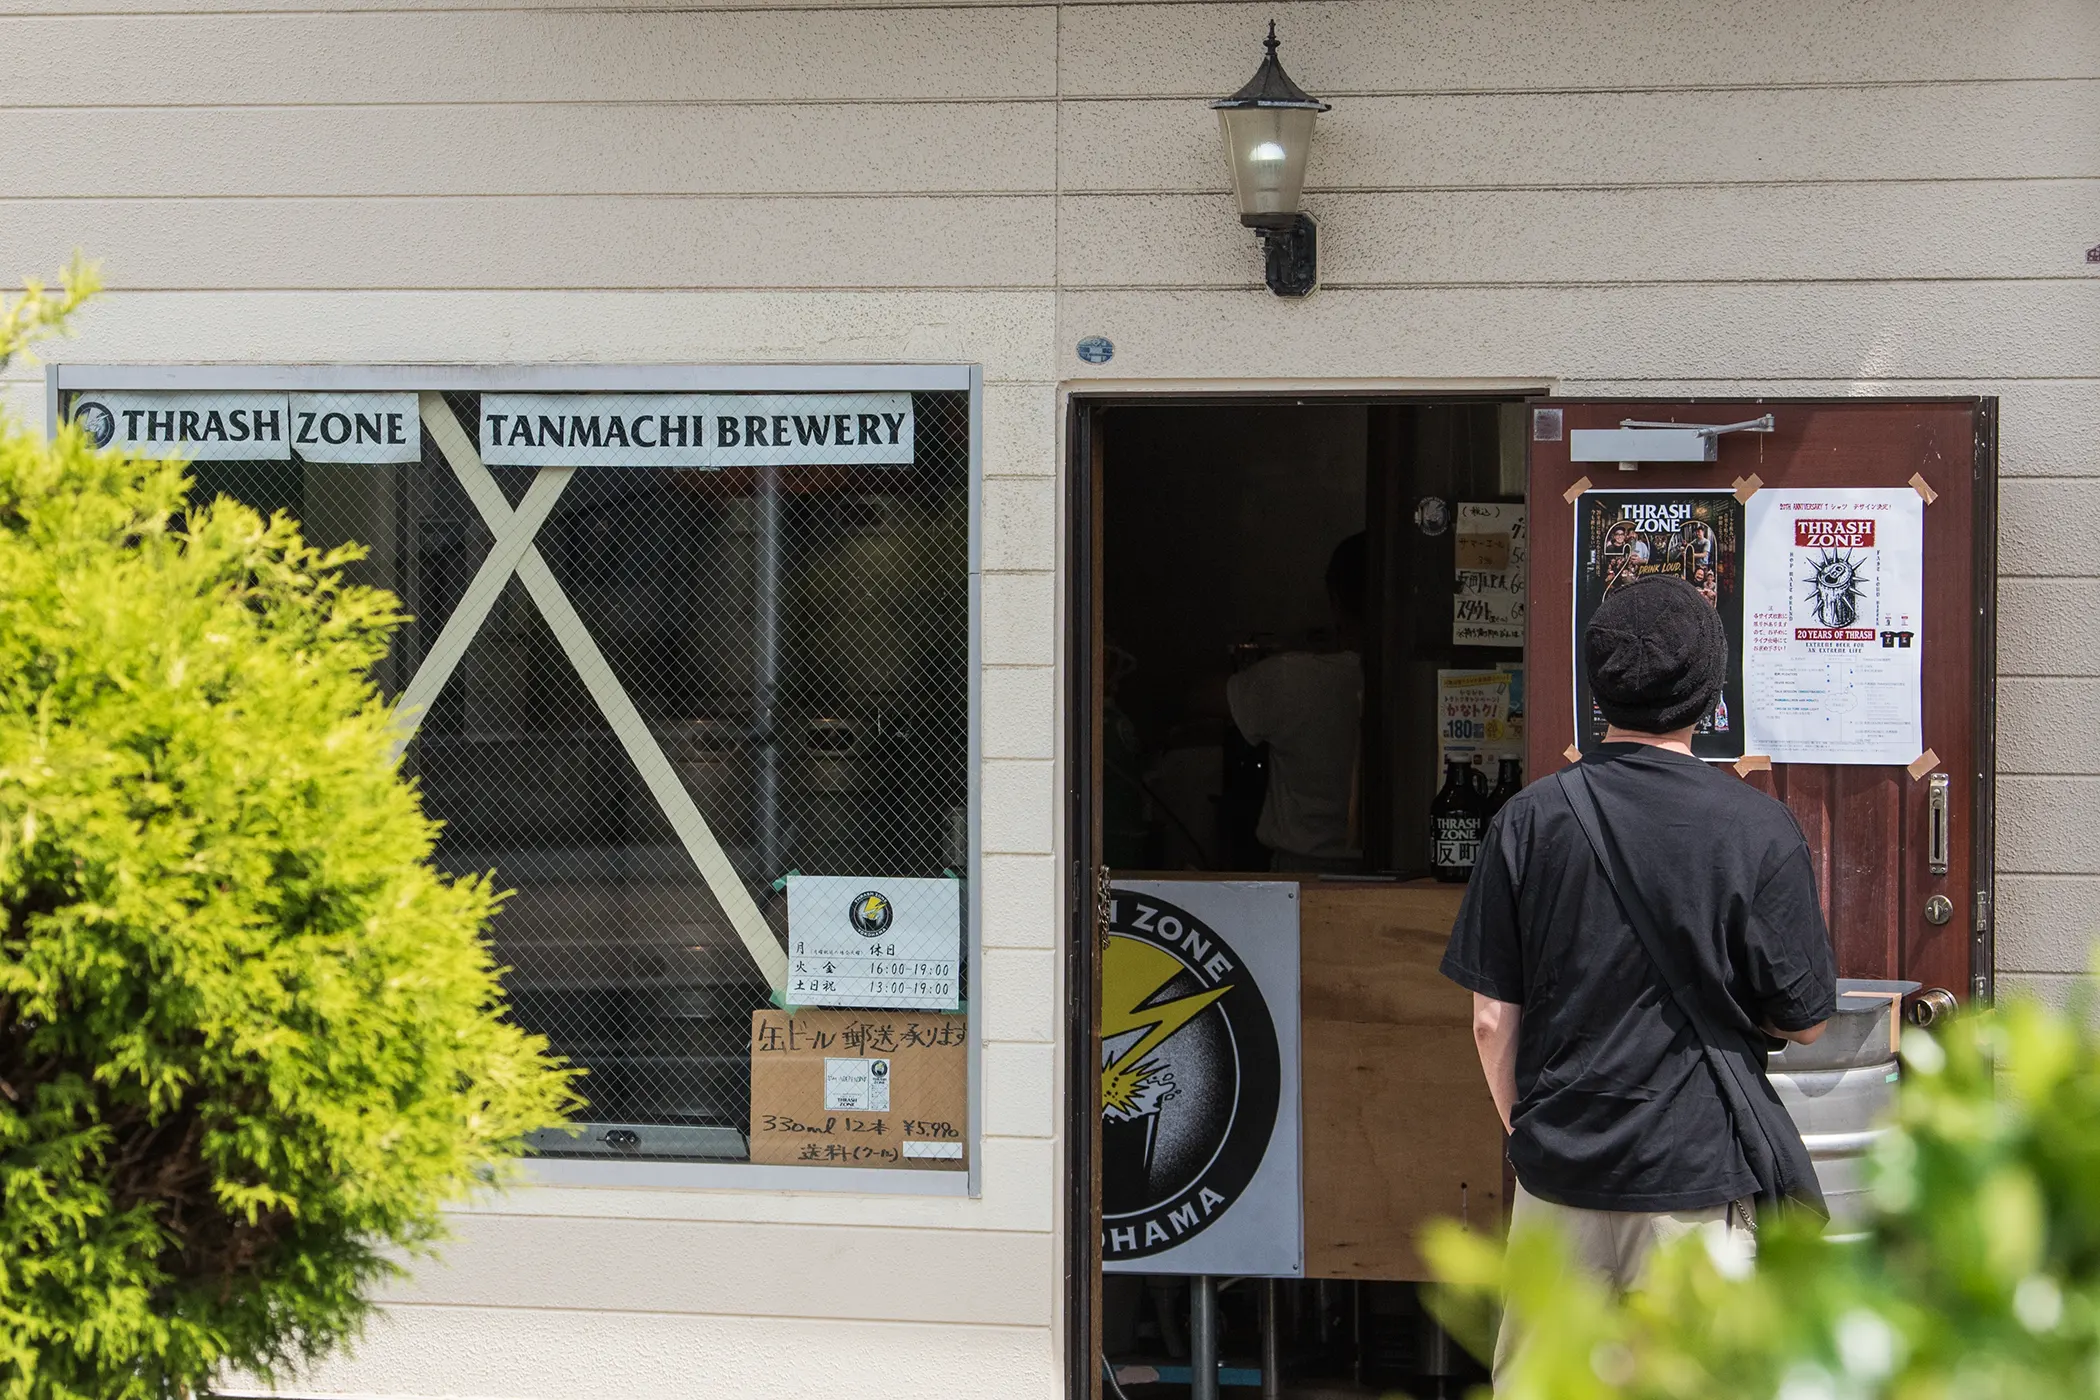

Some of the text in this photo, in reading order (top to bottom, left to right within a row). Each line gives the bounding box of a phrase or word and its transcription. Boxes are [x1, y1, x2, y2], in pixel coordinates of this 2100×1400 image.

[122, 409, 407, 446] THRASH ZONE
[486, 412, 906, 448] TANMACHI BREWERY
[1621, 504, 1691, 519] THRASH
[1635, 519, 1681, 532] ZONE
[1797, 521, 1872, 534] THRASH
[1807, 534, 1864, 547] ZONE
[1638, 562, 1682, 575] DRINK LOUD.
[1456, 600, 1490, 621] スタウト
[1797, 630, 1873, 640] 20 YEARS OF THRASH
[1447, 719, 1472, 739] 180
[1437, 818, 1481, 829] THRASH
[1440, 829, 1477, 840] ZONE
[1438, 842, 1480, 865] 反町
[795, 941, 805, 955] 月
[870, 943, 895, 956] 休日
[1132, 902, 1235, 983] ZONE
[870, 961, 949, 977] 16:00-19:00
[794, 979, 949, 995] 土日祝 13:00-19:00
[762, 1115, 837, 1135] 330ml
[1101, 1185, 1225, 1253] HAMA
